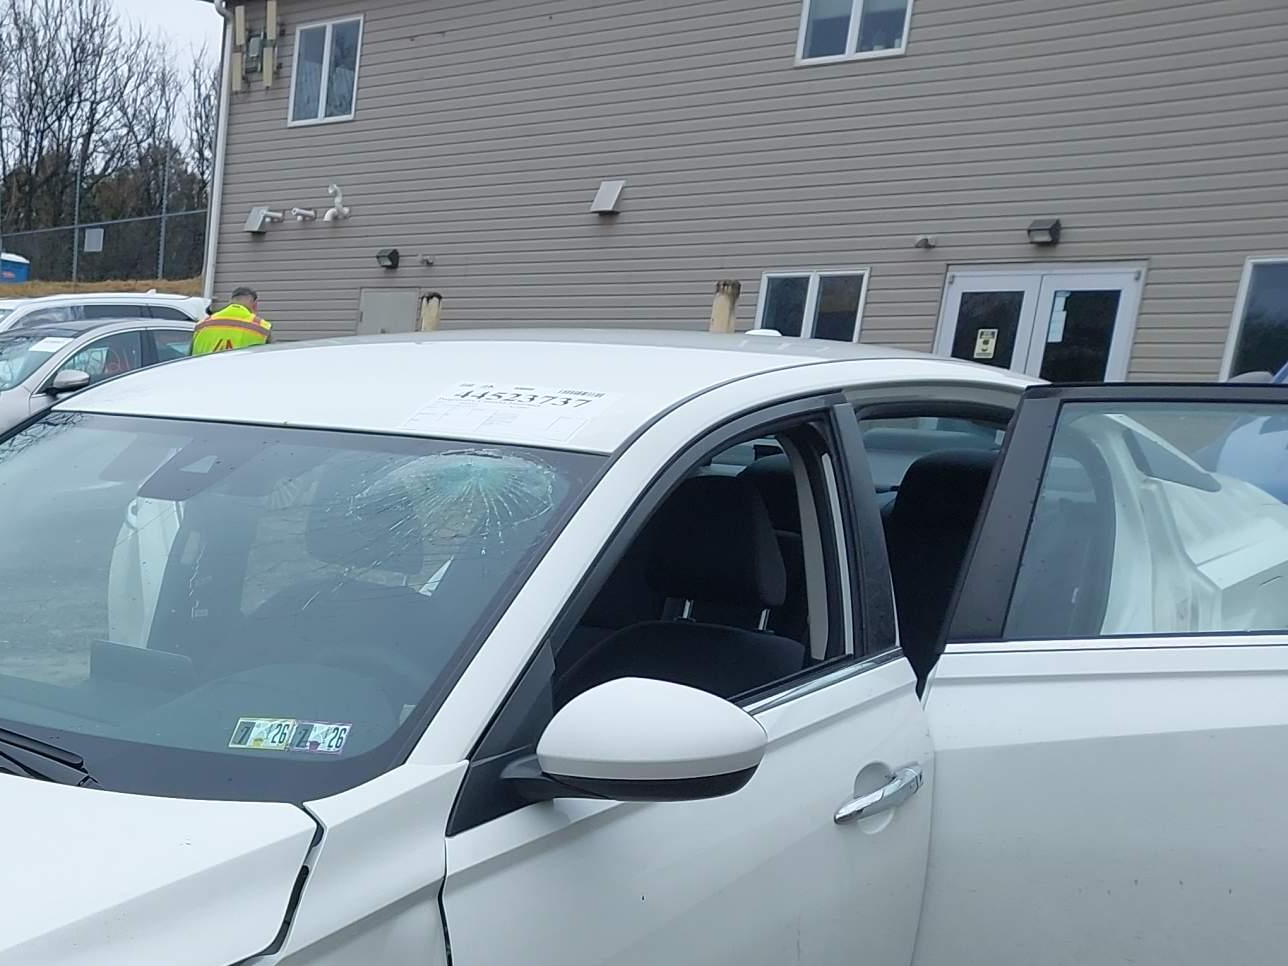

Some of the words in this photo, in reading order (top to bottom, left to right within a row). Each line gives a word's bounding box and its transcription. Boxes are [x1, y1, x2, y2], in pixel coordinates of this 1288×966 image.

[454, 390, 593, 408] 44523737
[270, 723, 290, 744] 26
[327, 727, 347, 749] 26
